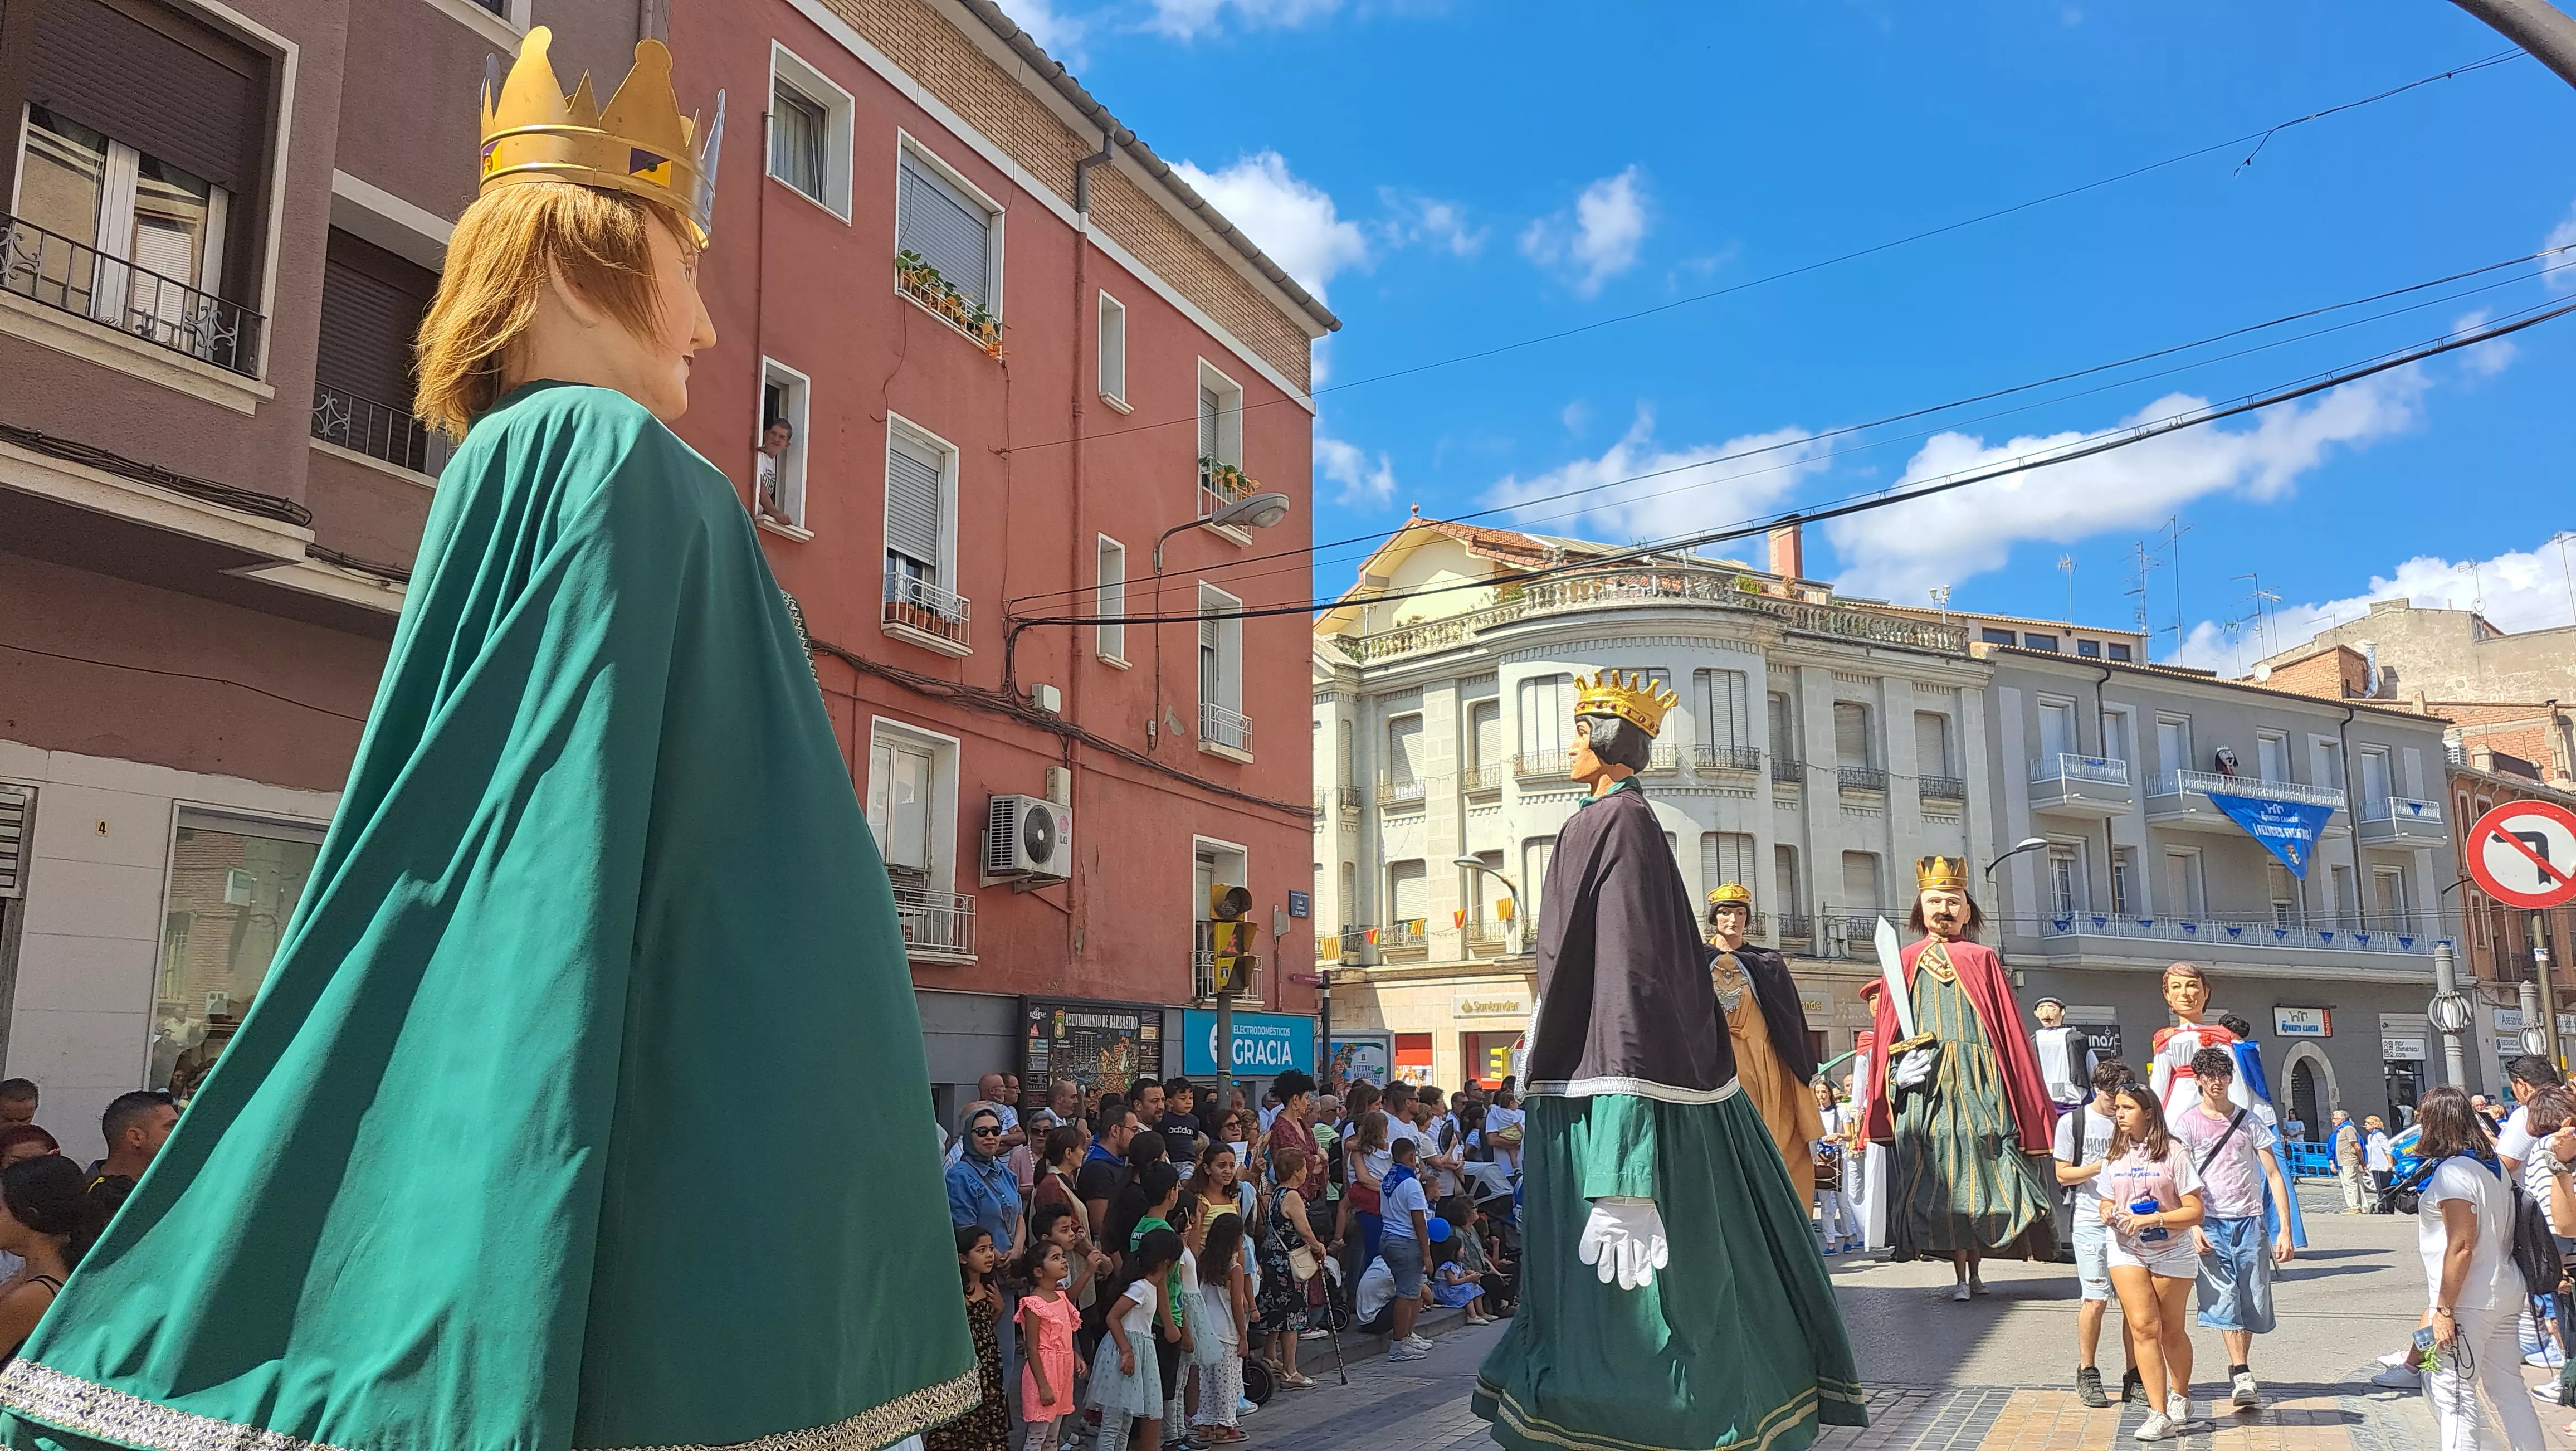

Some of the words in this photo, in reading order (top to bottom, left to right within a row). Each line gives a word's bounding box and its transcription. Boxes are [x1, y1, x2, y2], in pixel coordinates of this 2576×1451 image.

[98, 821, 107, 835] 4
[1060, 835, 1067, 845] LG
[1473, 1000, 1520, 1011] Santander
[1065, 1013, 1101, 1028] AYUNTAMIENTO
[1102, 1015, 1109, 1028] DE
[1109, 1016, 1139, 1030] BARBASTRO
[1233, 1025, 1291, 1036] ELECTRODOMÉSTICOS
[2088, 1035, 2114, 1047] inas
[1232, 1038, 1293, 1065] GRACIA
